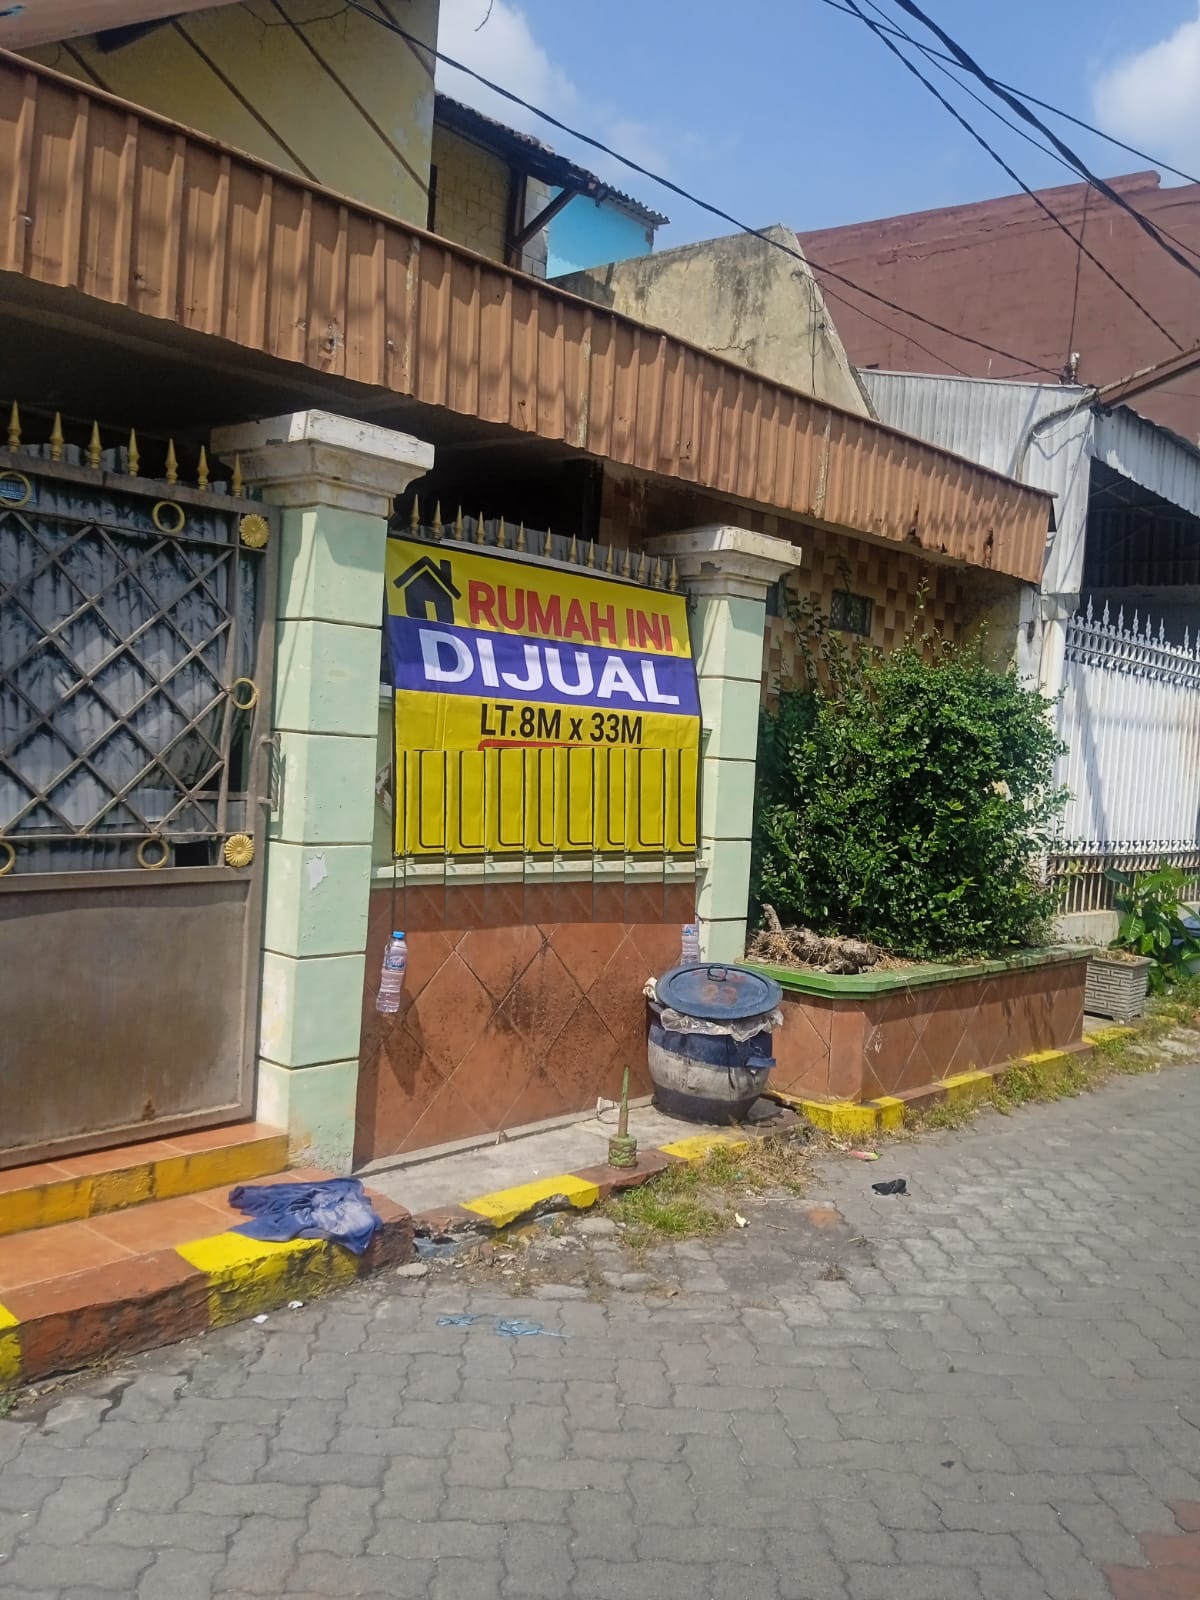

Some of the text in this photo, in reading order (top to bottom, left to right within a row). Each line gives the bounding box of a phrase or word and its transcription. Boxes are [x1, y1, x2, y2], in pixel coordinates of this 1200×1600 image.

[468, 580, 673, 651] RUMAH INI
[419, 629, 680, 705] DIJUAL
[481, 703, 642, 744] LT.8M x 33M
